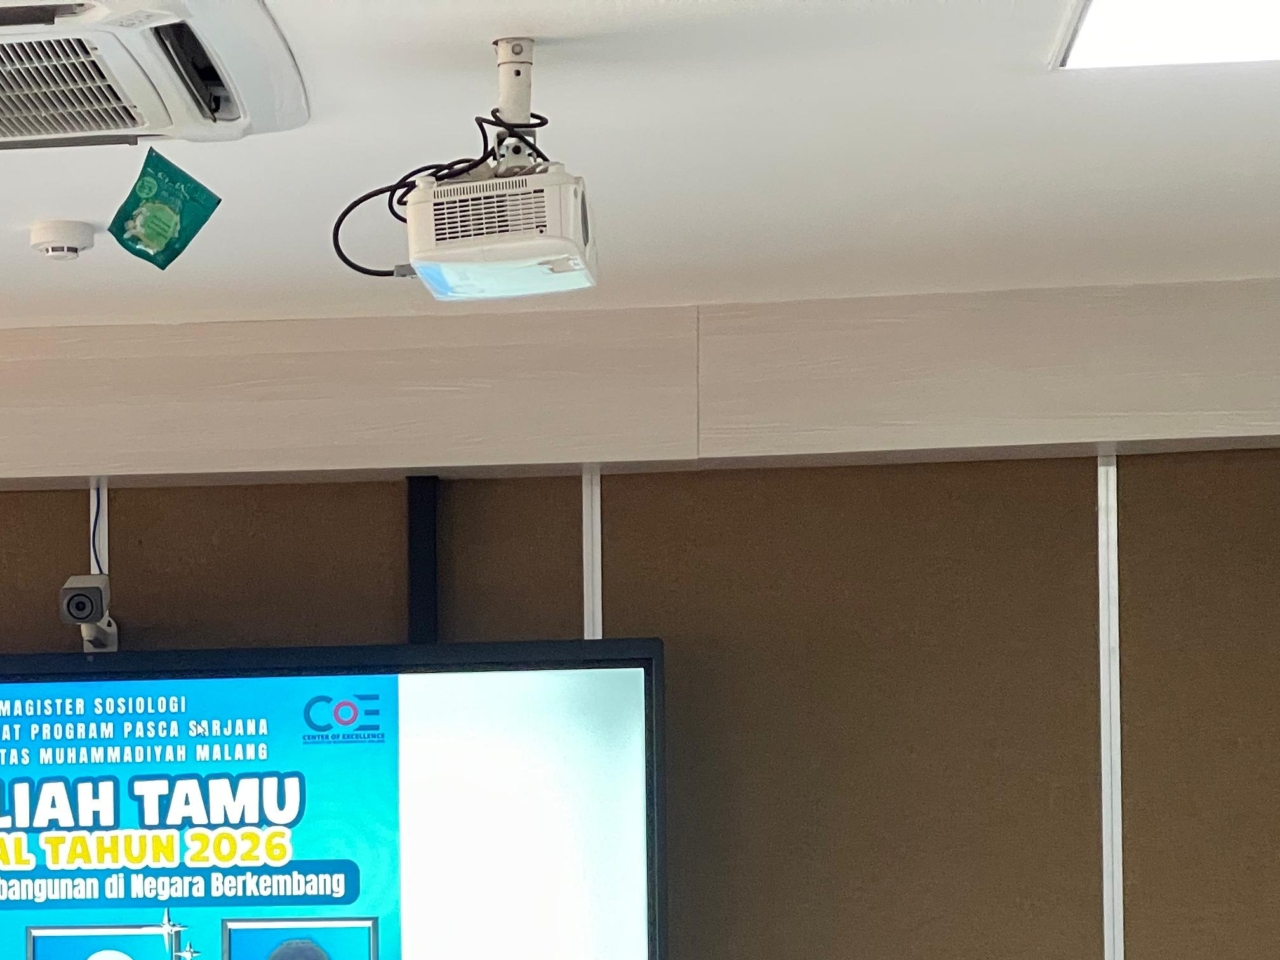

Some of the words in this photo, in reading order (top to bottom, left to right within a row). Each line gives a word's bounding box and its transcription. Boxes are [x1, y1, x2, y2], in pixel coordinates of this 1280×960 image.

[94, 695, 187, 715] SOSIOLOGI
[303, 694, 380, 732] COE
[30, 721, 114, 741] PROGRAM
[123, 720, 180, 738] PASCA
[188, 718, 269, 737] SARJANA
[302, 733, 330, 741] CENTER
[342, 732, 385, 740] EXCELLENCE
[39, 744, 187, 765] MUHAMMADIYAH
[196, 742, 269, 762] MALANG
[132, 776, 302, 826] TAMU
[44, 831, 176, 865] TAHUN
[188, 830, 288, 863] 2026
[104, 873, 125, 899] di
[130, 873, 206, 901] Negara
[210, 871, 346, 898] Berkembang
